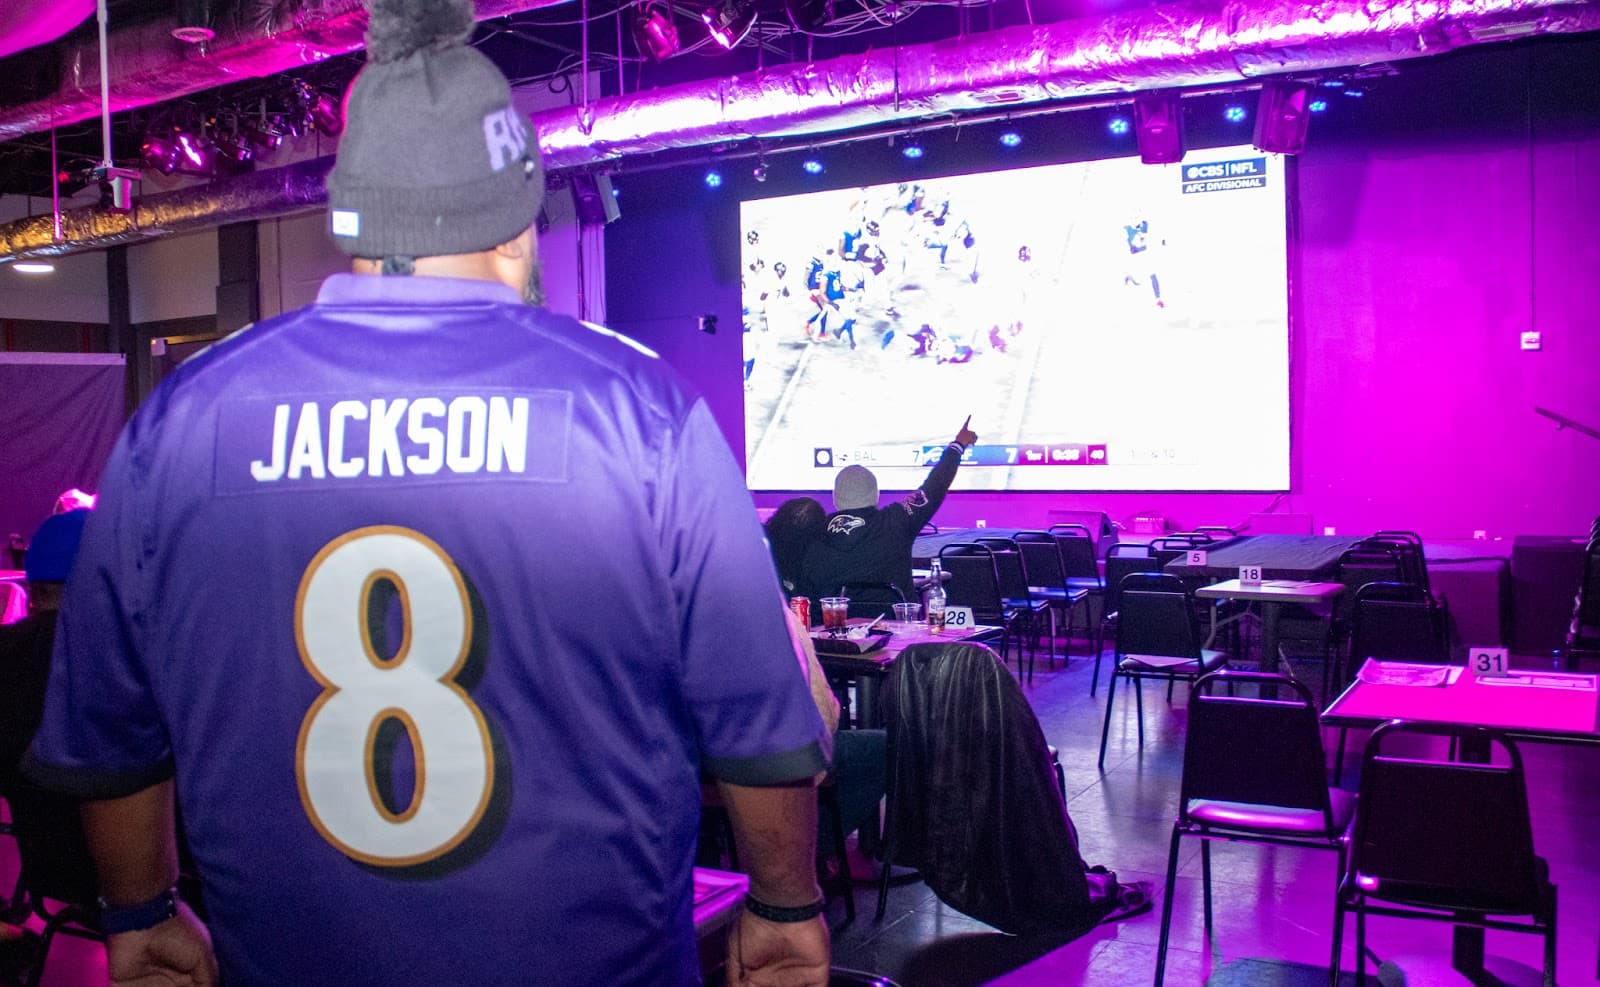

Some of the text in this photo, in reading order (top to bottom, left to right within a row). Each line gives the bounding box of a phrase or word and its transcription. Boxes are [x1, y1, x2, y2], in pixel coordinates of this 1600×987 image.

[1199, 162, 1258, 177] CBS NFL
[1185, 179, 1261, 193] AFC DIVISIONAL
[250, 396, 530, 482] JACKSON
[854, 450, 877, 461] BAL
[912, 450, 920, 463] 7
[1005, 447, 1018, 464] 7
[1192, 553, 1200, 563] 5
[1242, 568, 1259, 580] 18
[945, 610, 966, 625] 28
[1477, 654, 1502, 672] 31
[294, 524, 495, 867] 8
